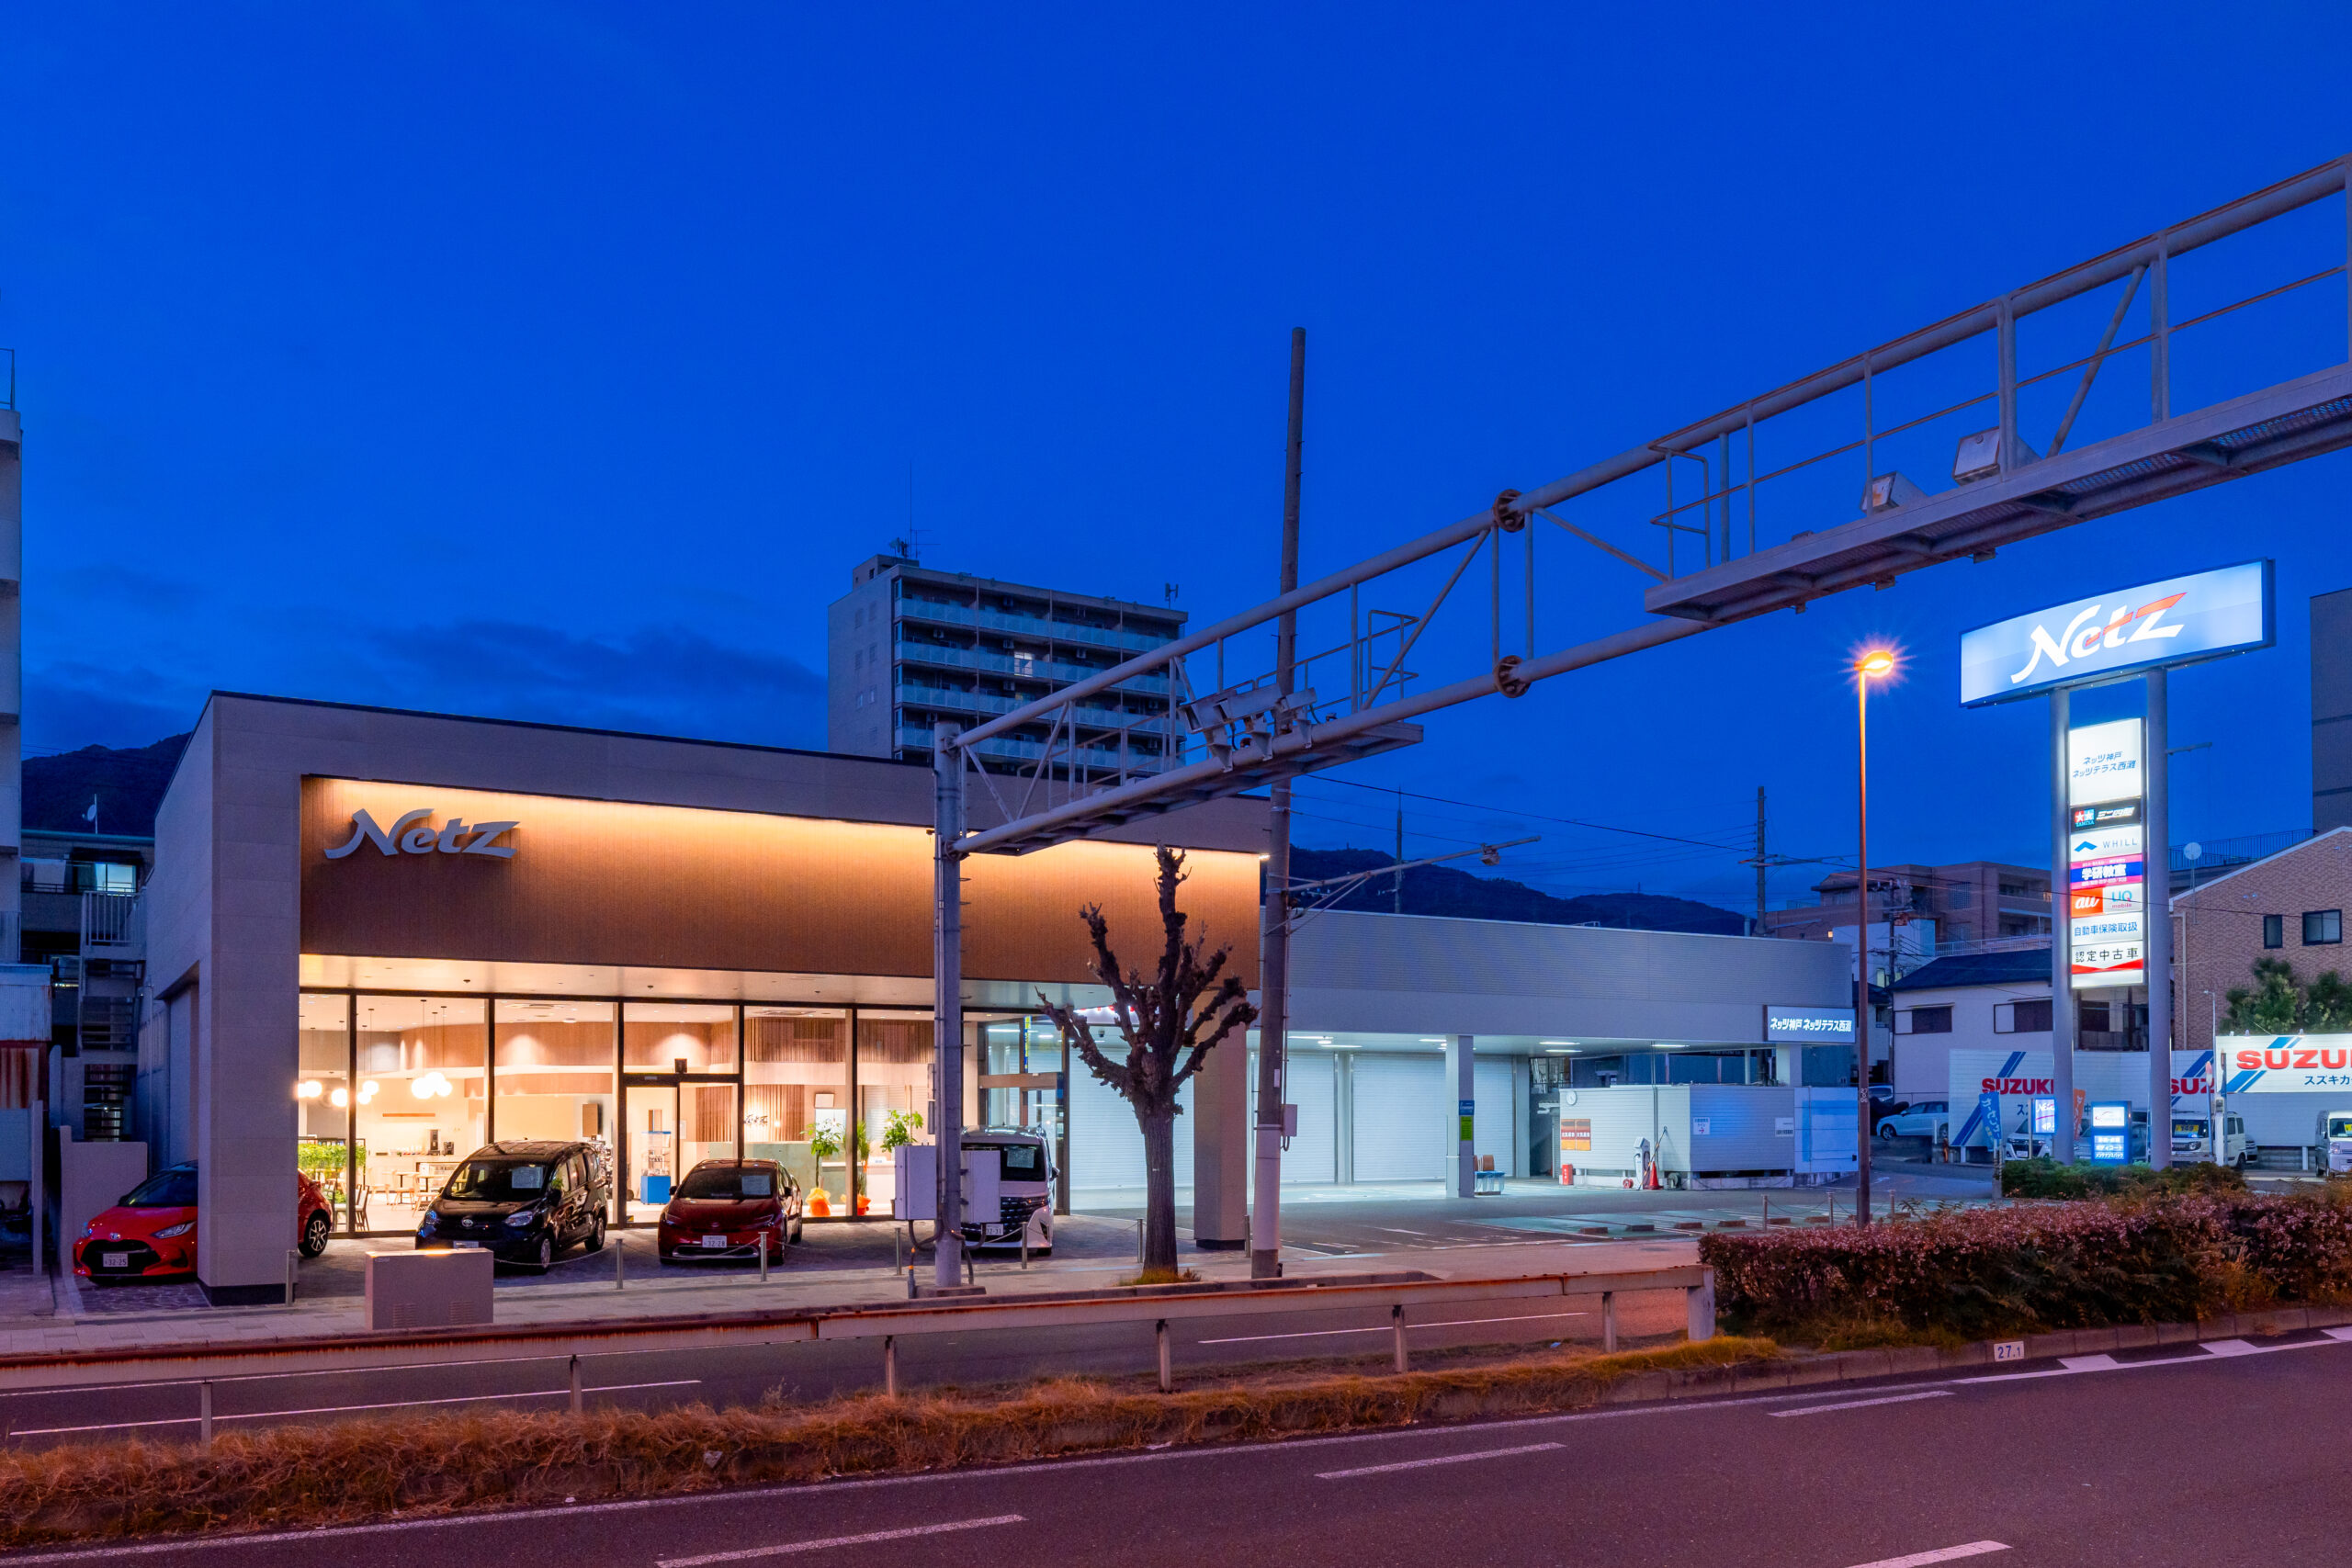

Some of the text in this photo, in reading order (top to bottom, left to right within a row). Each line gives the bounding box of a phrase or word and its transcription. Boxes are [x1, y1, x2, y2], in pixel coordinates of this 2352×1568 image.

[2011, 592, 2187, 683] Netz
[2084, 750, 2122, 764] ネッツ神戸
[2072, 760, 2136, 779] ネッツテラス西灘
[324, 808, 520, 859] Netz
[2102, 838, 2138, 849] WHILL
[2075, 897, 2099, 909] au
[2111, 890, 2132, 902] UQ
[2074, 921, 2138, 937] 自動車保険取扱
[2075, 947, 2139, 963] 認定中古車
[1770, 1017, 1803, 1031] ネッツ神戸
[2236, 1049, 2352, 1069] SUZU
[2304, 1075, 2352, 1086] スズキカ
[1997, 1345, 2021, 1359] 27.1
